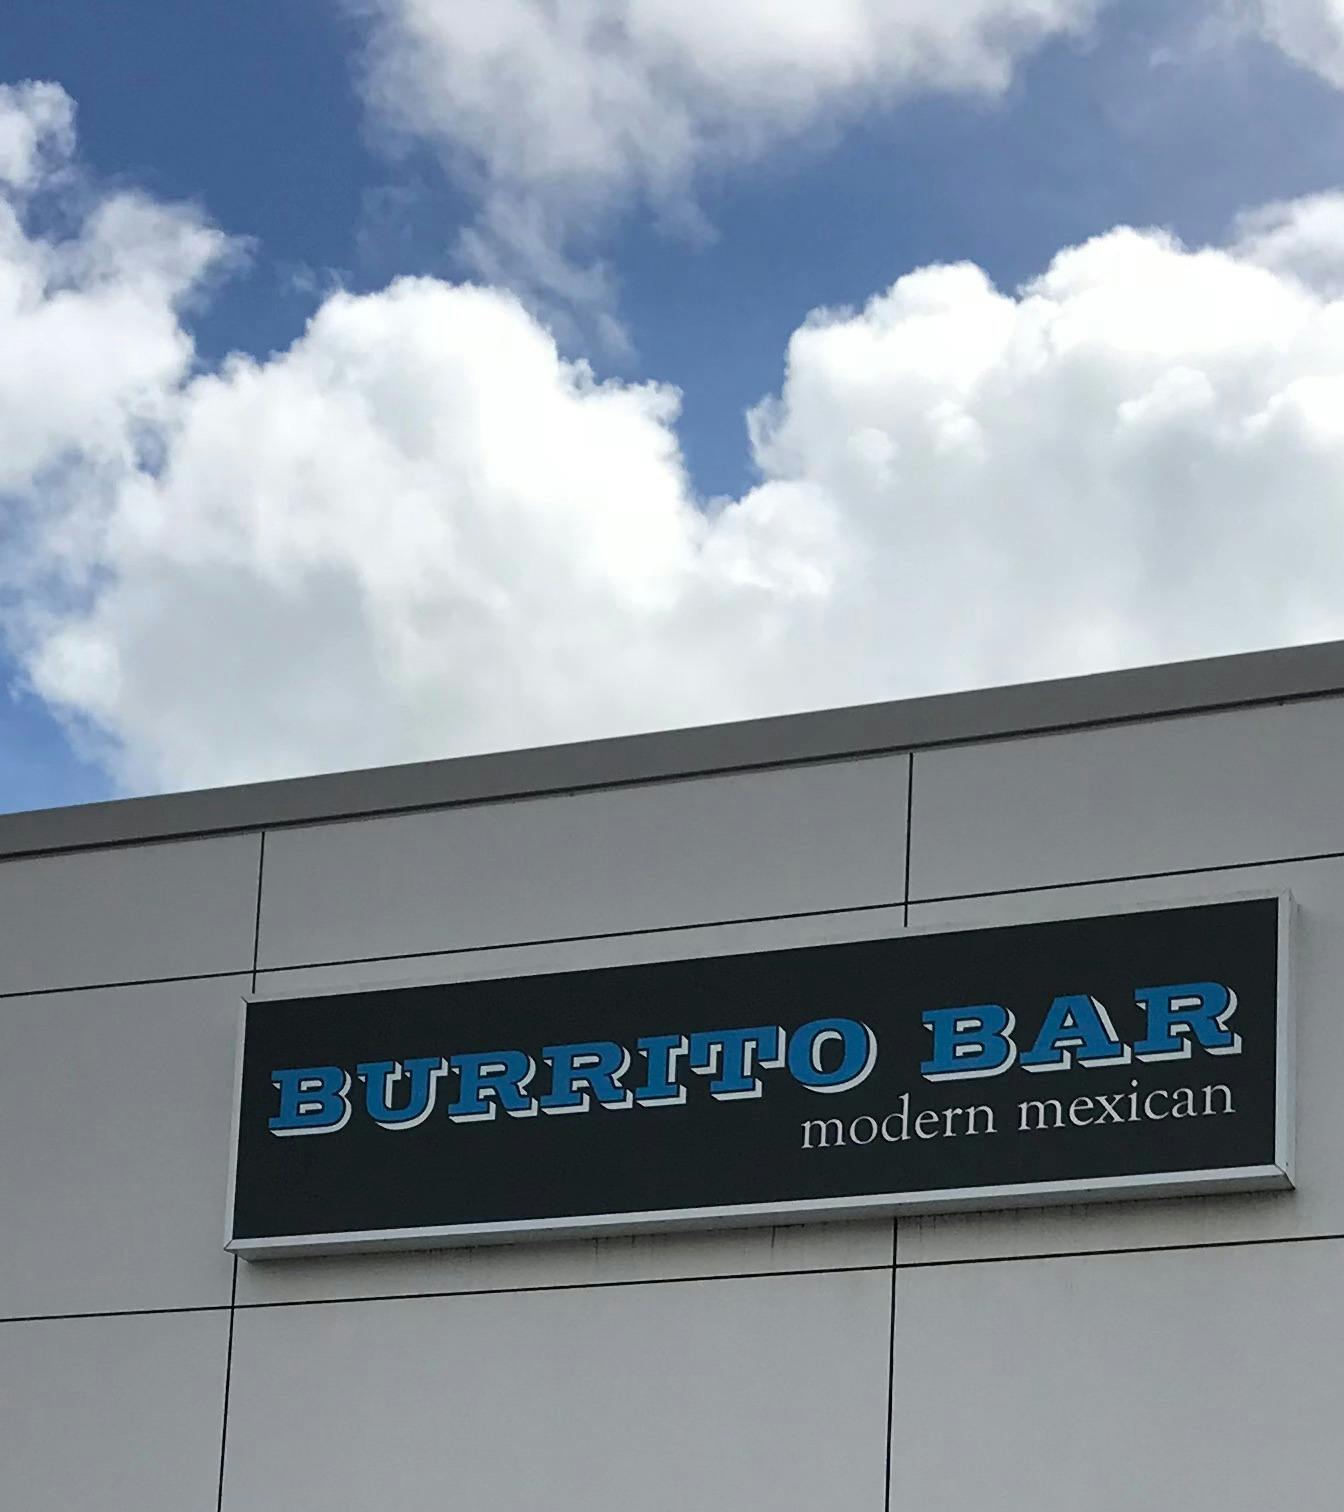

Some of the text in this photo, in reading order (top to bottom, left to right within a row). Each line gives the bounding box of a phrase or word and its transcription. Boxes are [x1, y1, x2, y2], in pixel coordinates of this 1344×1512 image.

[268, 981, 1243, 1137] BURRITO BAR
[801, 1078, 1237, 1150] modern mexican
